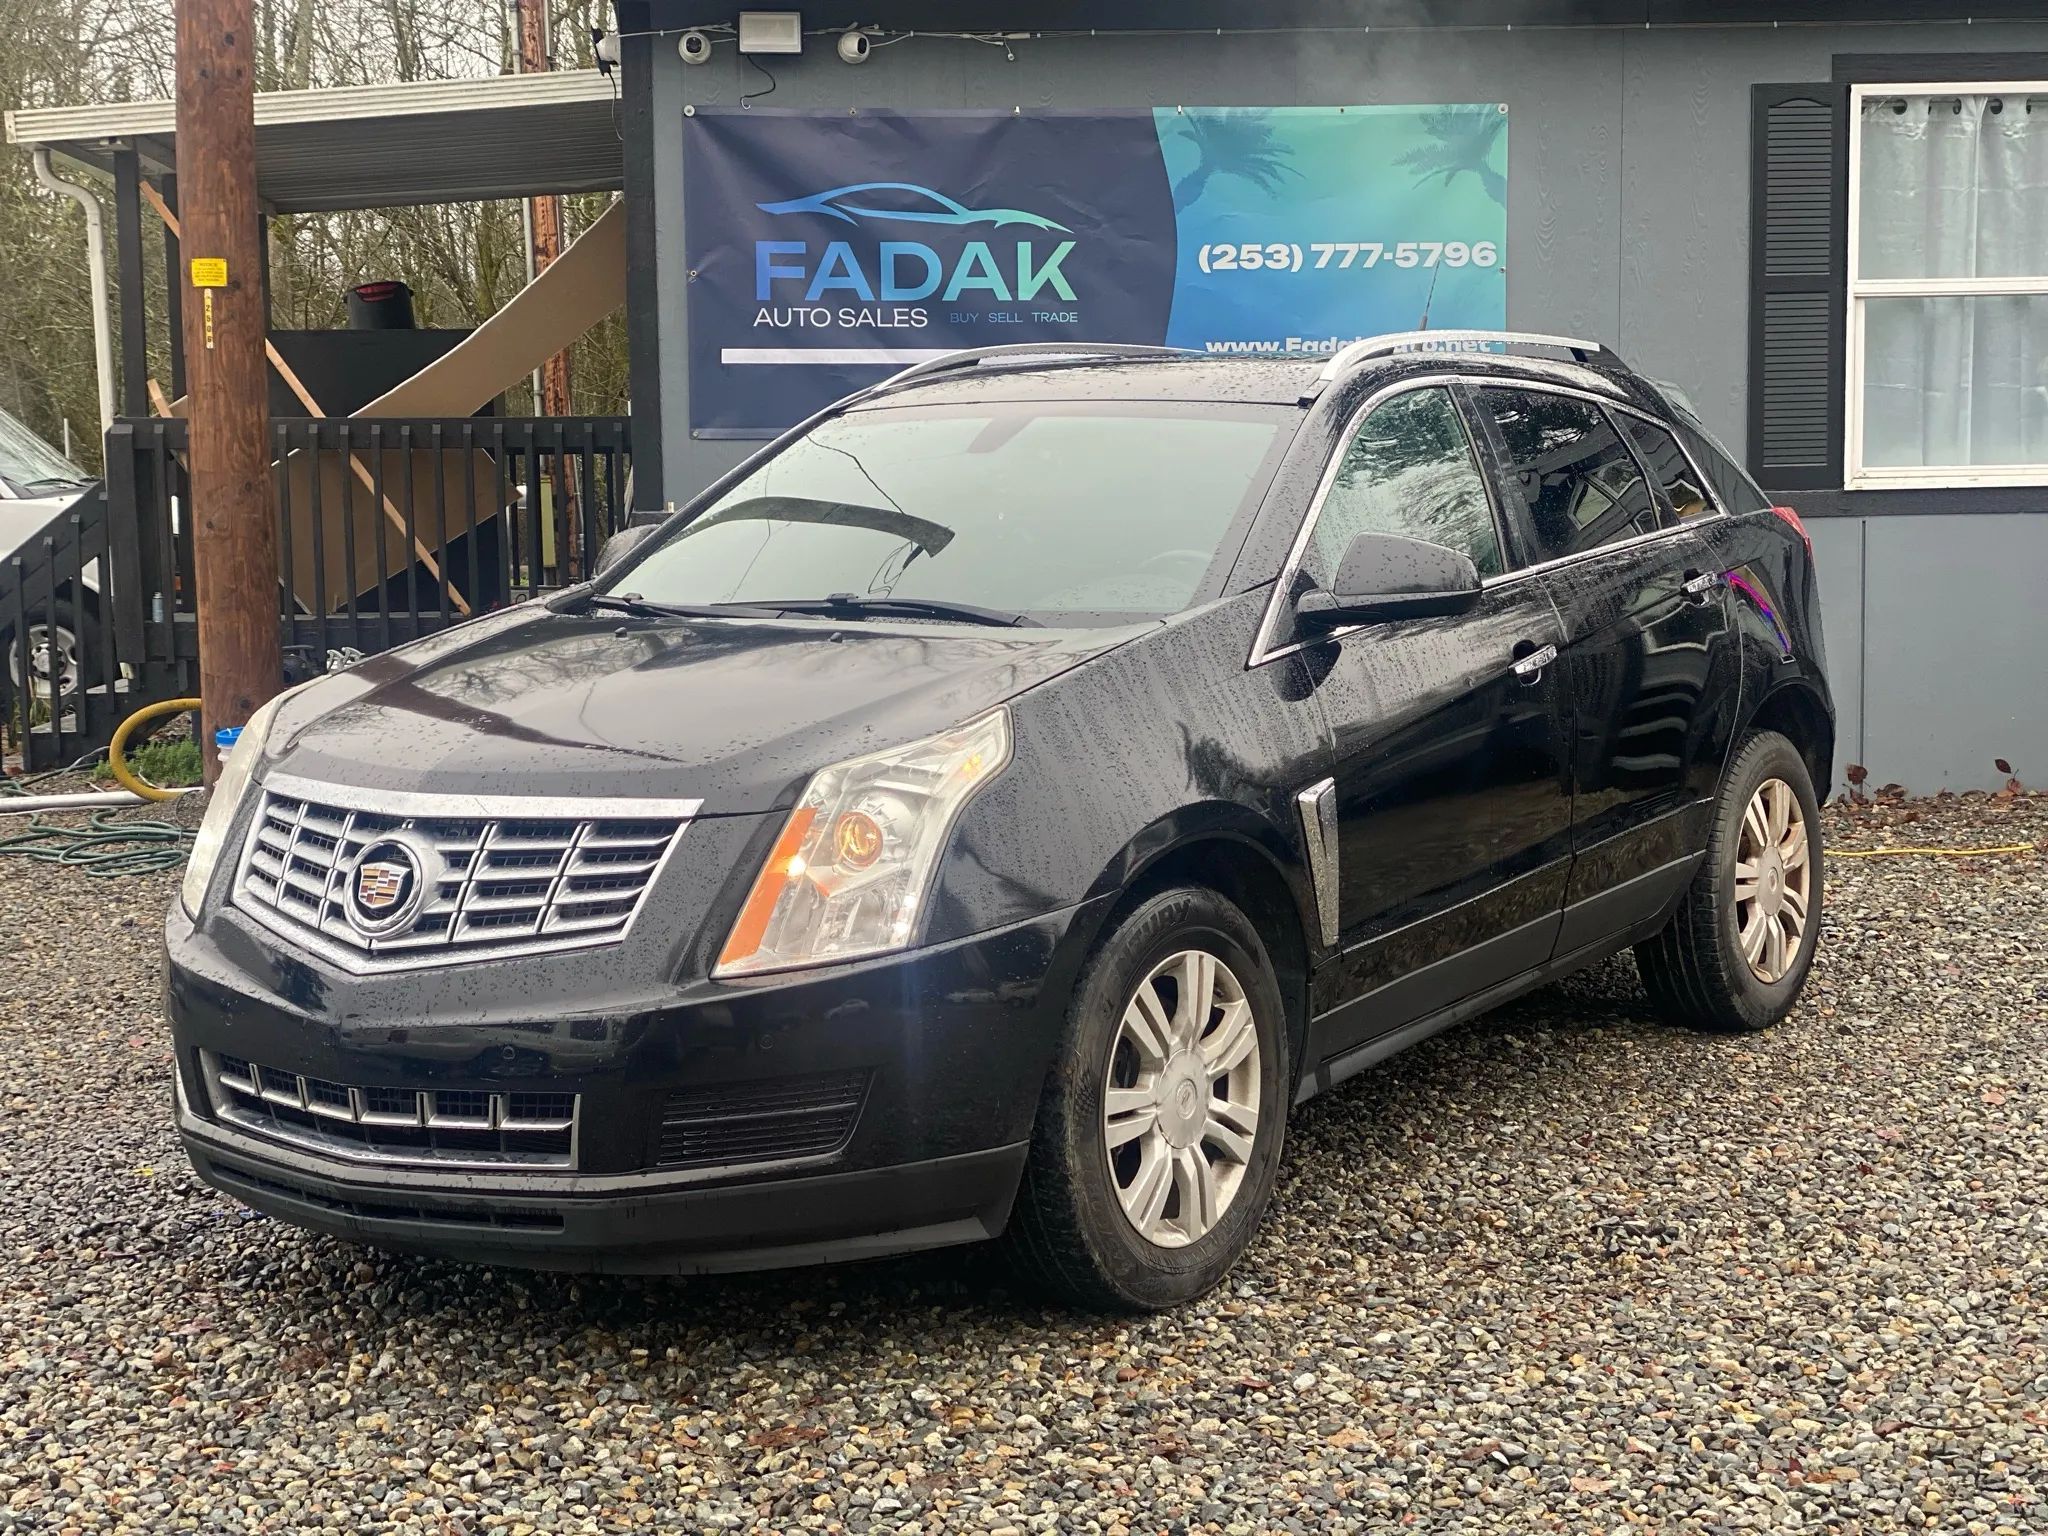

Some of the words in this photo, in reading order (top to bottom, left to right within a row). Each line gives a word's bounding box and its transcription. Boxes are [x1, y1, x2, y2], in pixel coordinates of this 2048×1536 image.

[1198, 243, 1304, 273] (253)
[1310, 241, 1497, 270] 777-5796
[755, 241, 1078, 301] FADAK
[753, 307, 832, 328] AUTO
[838, 307, 928, 328] SALES
[950, 312, 979, 323] BUY
[988, 312, 1024, 323] SELL
[1031, 312, 1078, 323] TRADE
